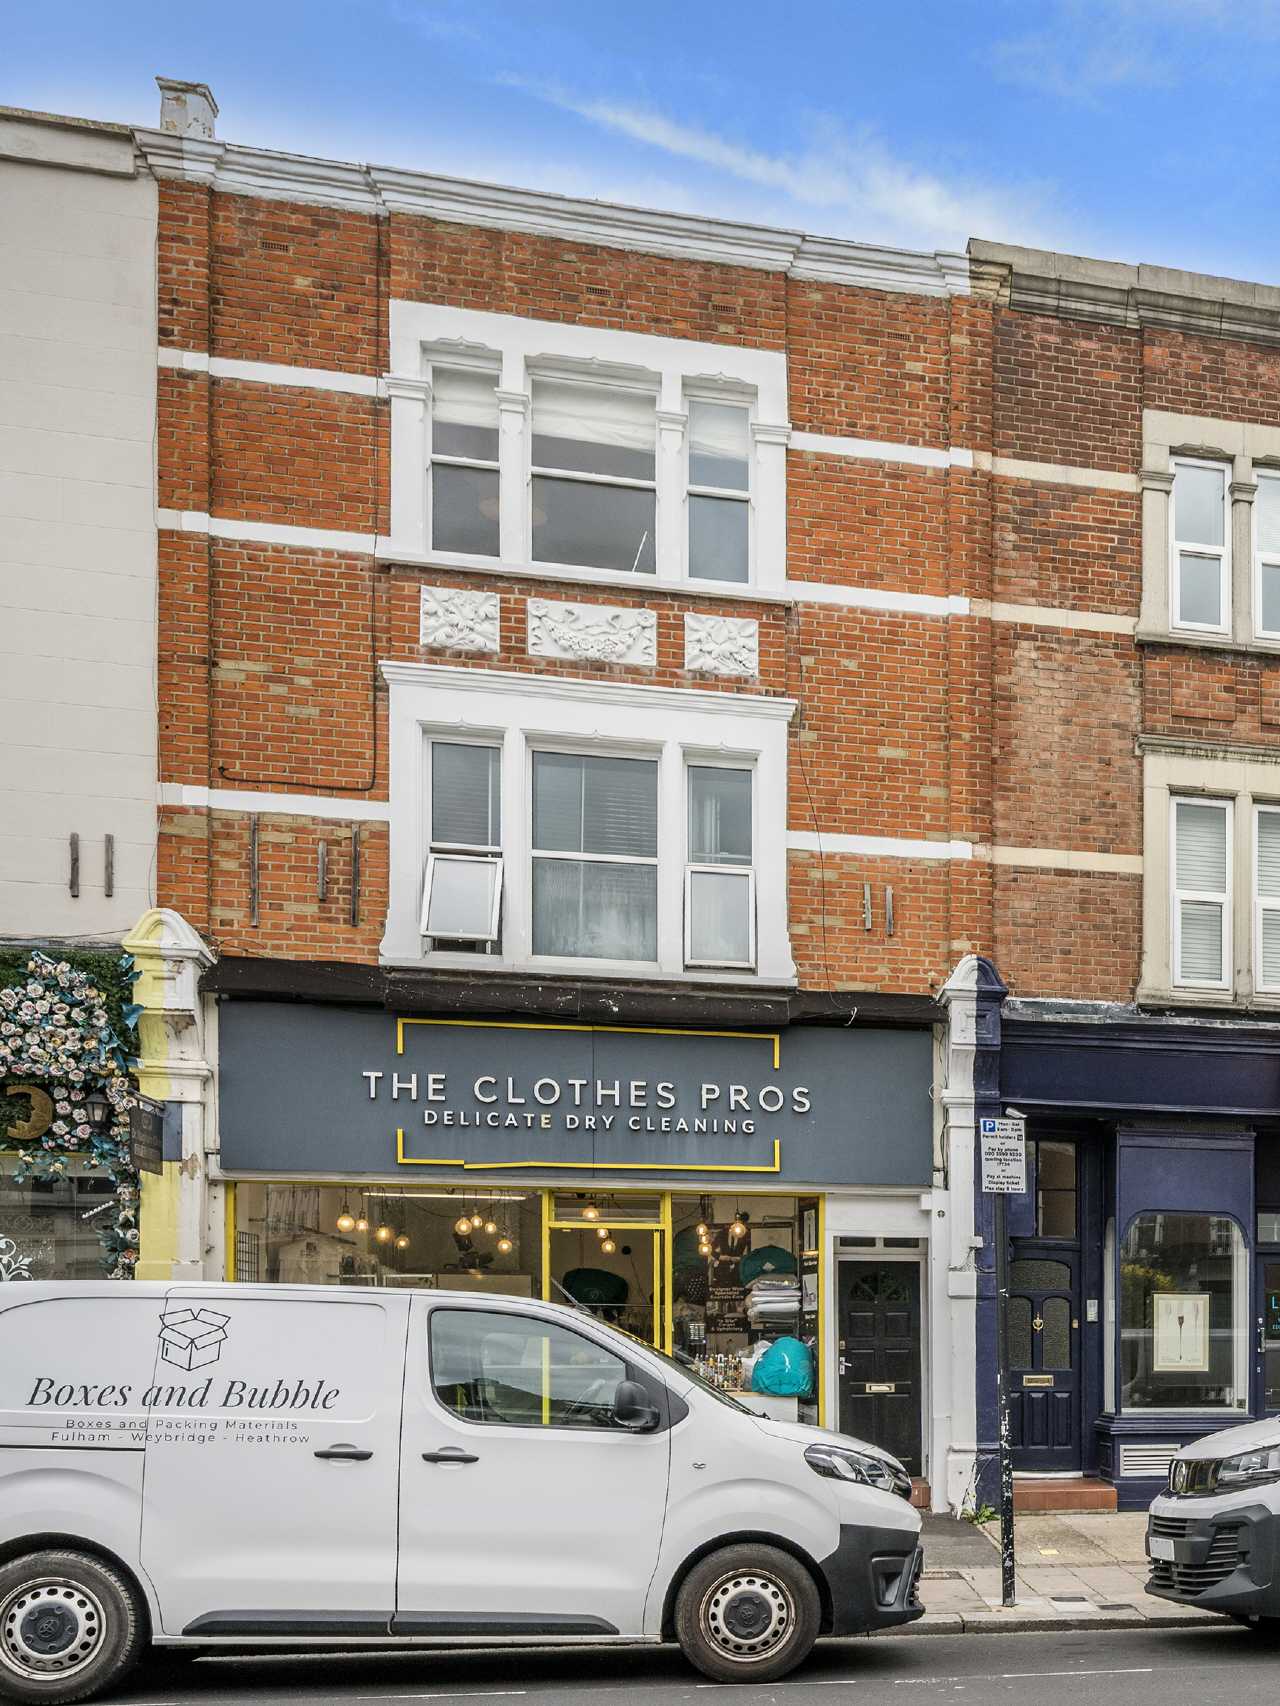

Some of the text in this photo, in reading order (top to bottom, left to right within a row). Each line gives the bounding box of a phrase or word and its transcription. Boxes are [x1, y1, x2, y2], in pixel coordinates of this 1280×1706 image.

[361, 1070, 812, 1114] THE CLOTHES PROS
[423, 1109, 756, 1134] DELICATE DRY CLEANING
[25, 1376, 341, 1411] Boxes and Bubble
[51, 1431, 111, 1442] Fulham
[131, 1431, 216, 1444] Weybridge
[235, 1432, 310, 1443] Heathrow
[66, 1419, 298, 1432] Boxes and Packing Materials
